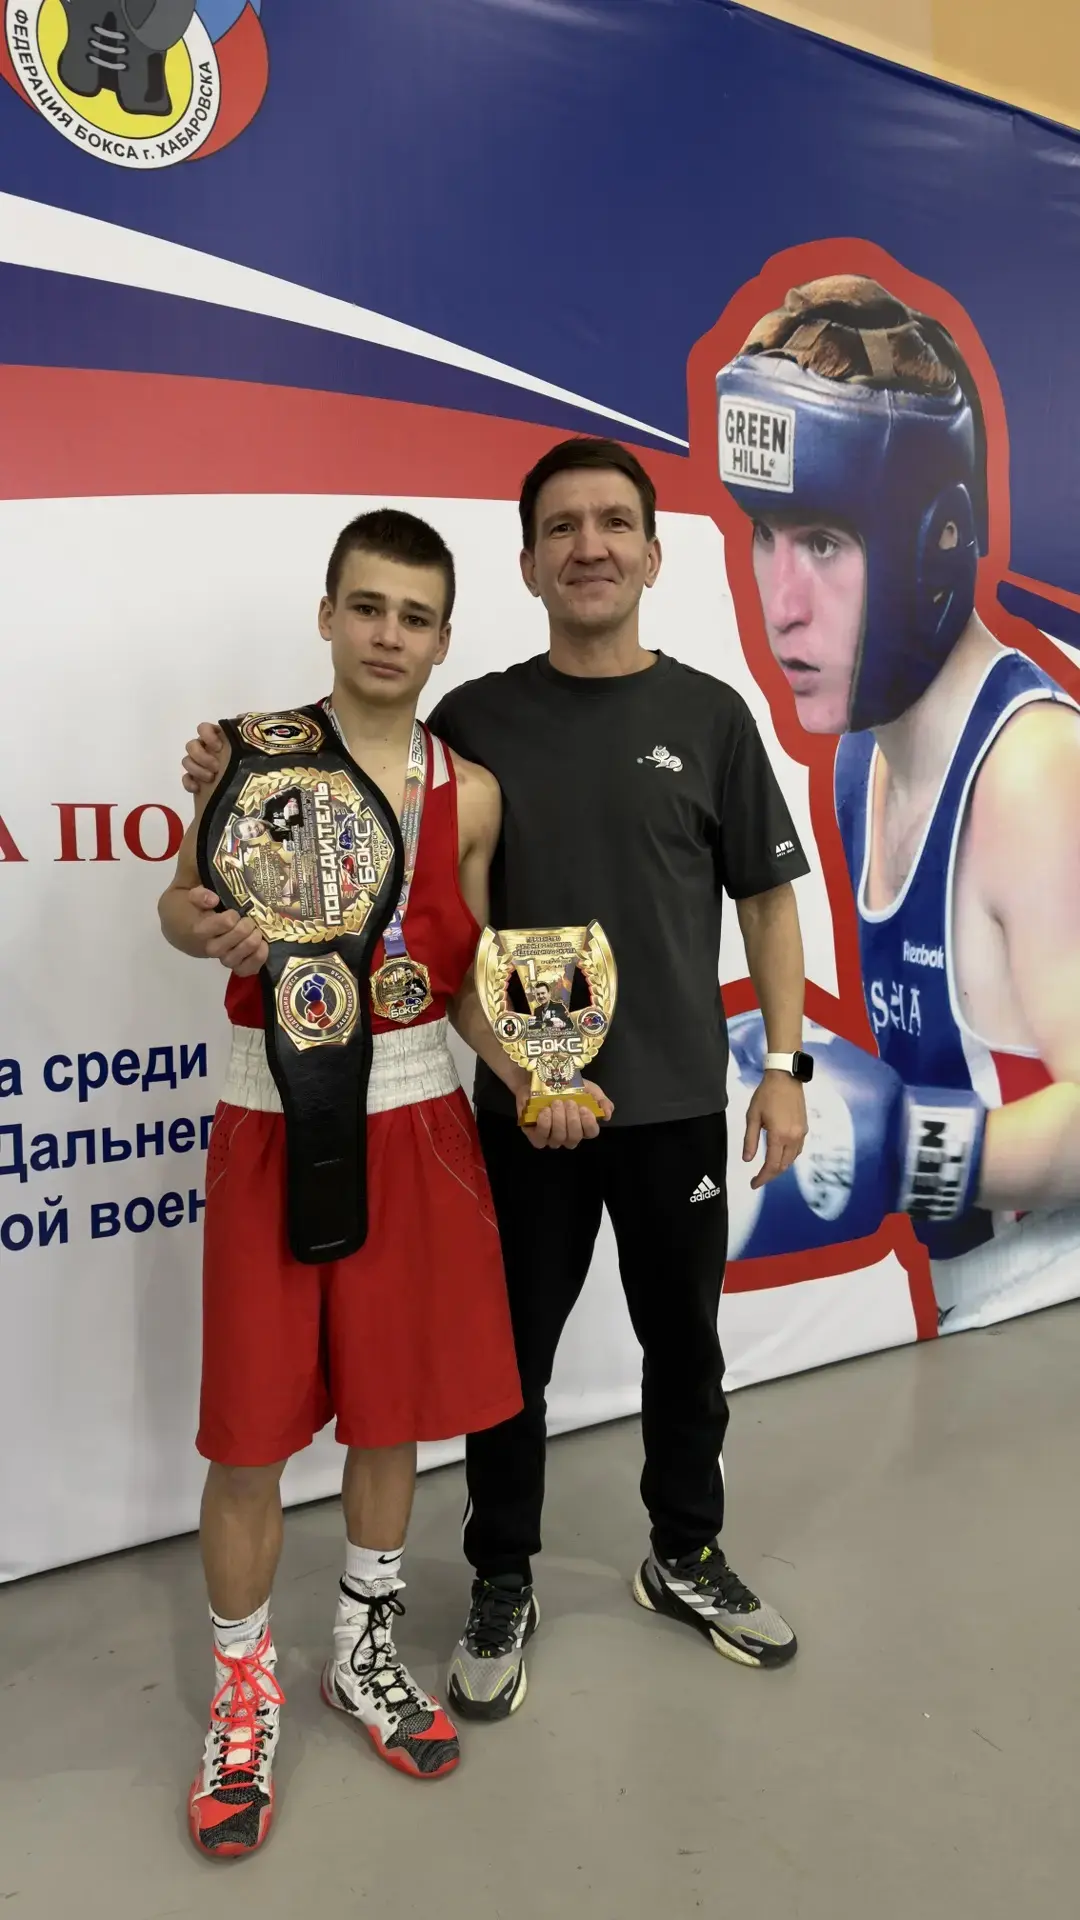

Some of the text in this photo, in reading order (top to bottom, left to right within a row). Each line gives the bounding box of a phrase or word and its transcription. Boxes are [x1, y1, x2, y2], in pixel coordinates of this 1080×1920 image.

[12, 9, 213, 160] ФЕДЕРАЦИЯ БОКСА г. ХАБАРОВСКА
[725, 408, 787, 454] GREEN
[732, 447, 772, 478] HILL
[51, 803, 185, 862] ПО
[313, 782, 342, 926] ПОБЕДИТЕЛЬ
[353, 819, 377, 884] БОКС
[390, 1004, 420, 1018] БОКС
[0, 1043, 207, 1103] а среди
[527, 1037, 583, 1056] БОКС
[0, 1195, 68, 1251] ой
[690, 1187, 720, 1203] adidas
